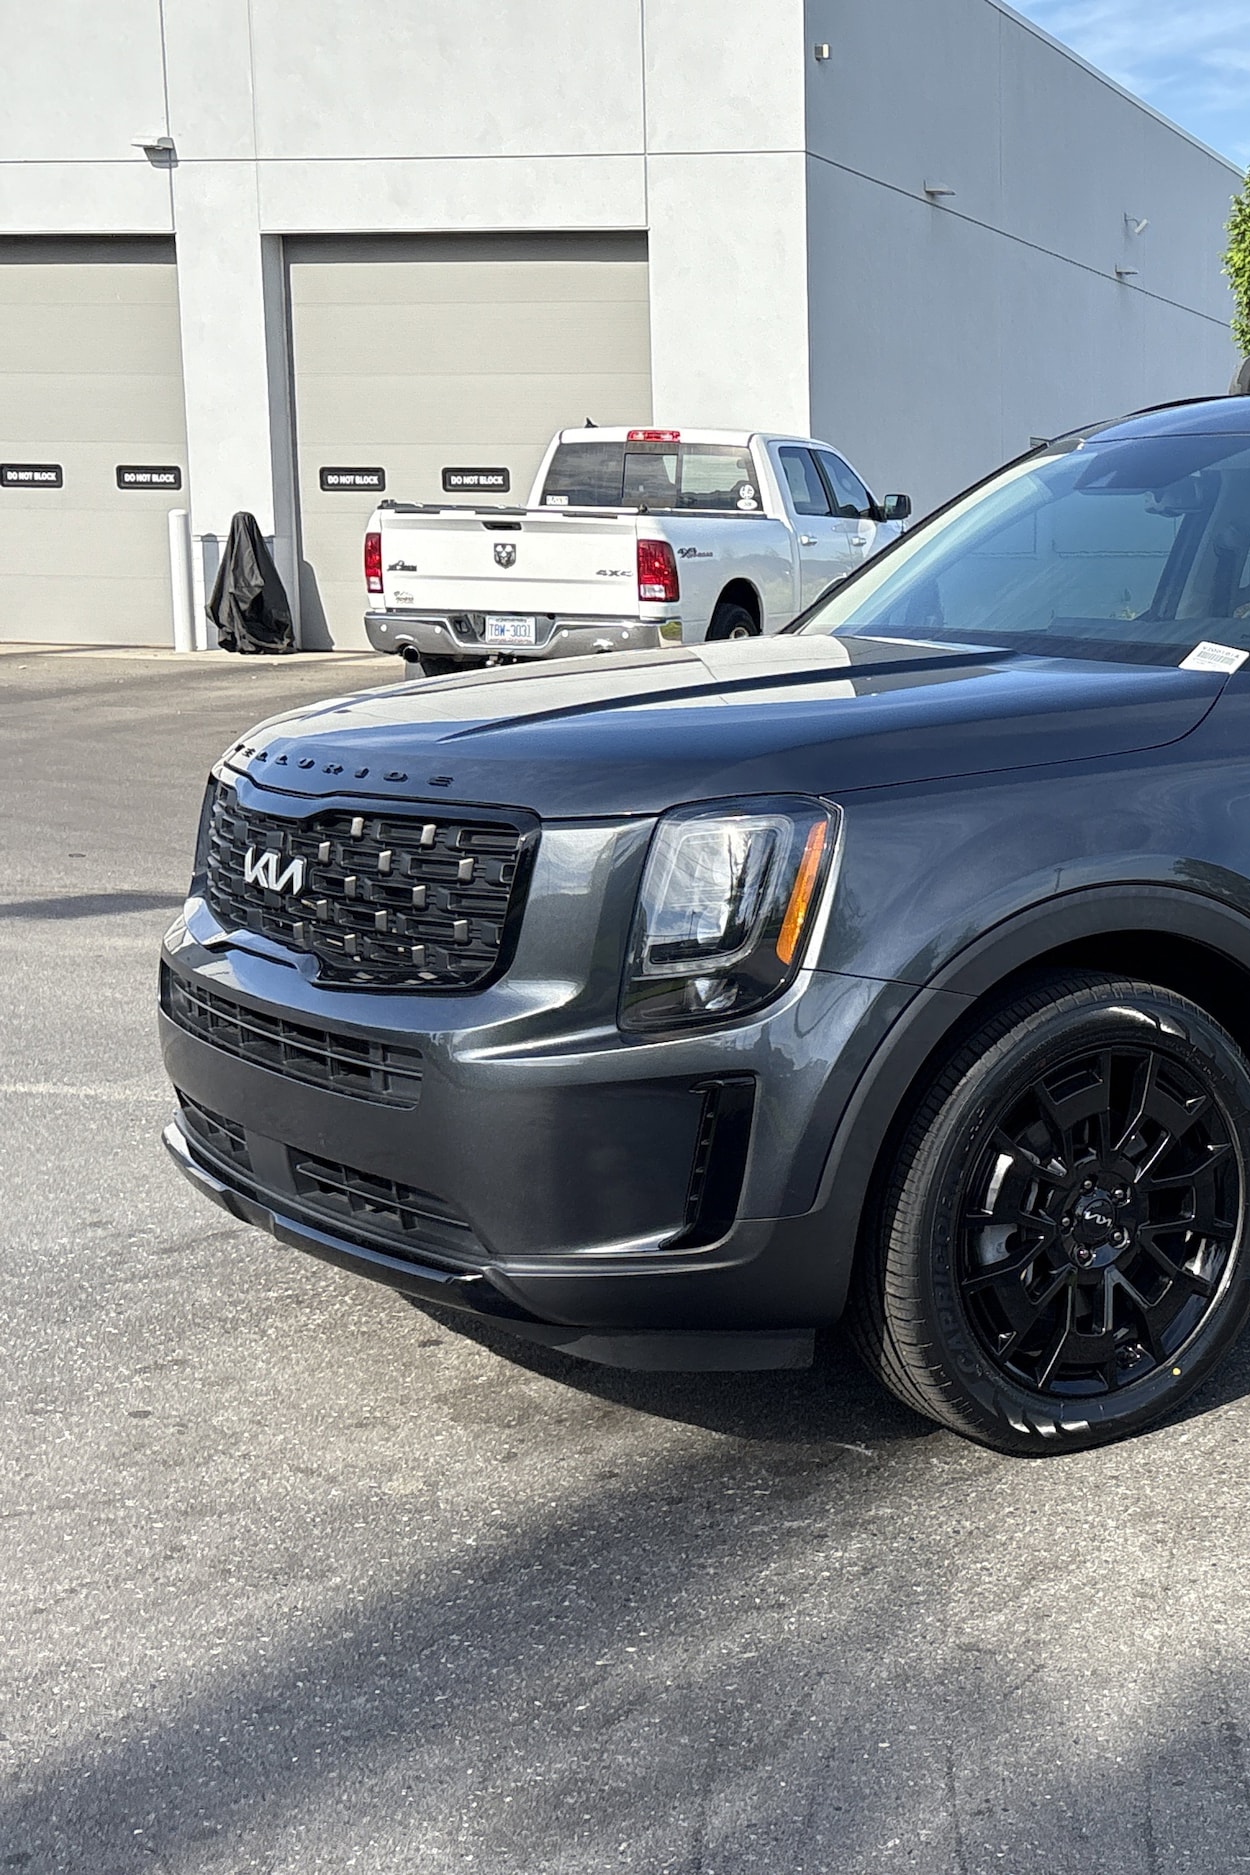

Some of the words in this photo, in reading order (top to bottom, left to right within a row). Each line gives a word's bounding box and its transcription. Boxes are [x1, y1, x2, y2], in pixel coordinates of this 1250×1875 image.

[6, 471, 18, 481] DO
[18, 471, 33, 481] NOT
[33, 471, 57, 481] BLOCK
[124, 473, 136, 483] DO
[136, 473, 151, 483] NOT
[151, 473, 175, 483] BLOCK
[327, 475, 339, 484] DO
[339, 475, 355, 484] NOT
[355, 475, 379, 485] BLOCK
[450, 475, 463, 485] DO
[463, 475, 478, 485] NOT
[479, 475, 504, 485] BLOCK
[234, 743, 456, 788] TELLURIDE
[243, 846, 304, 896] KIA
